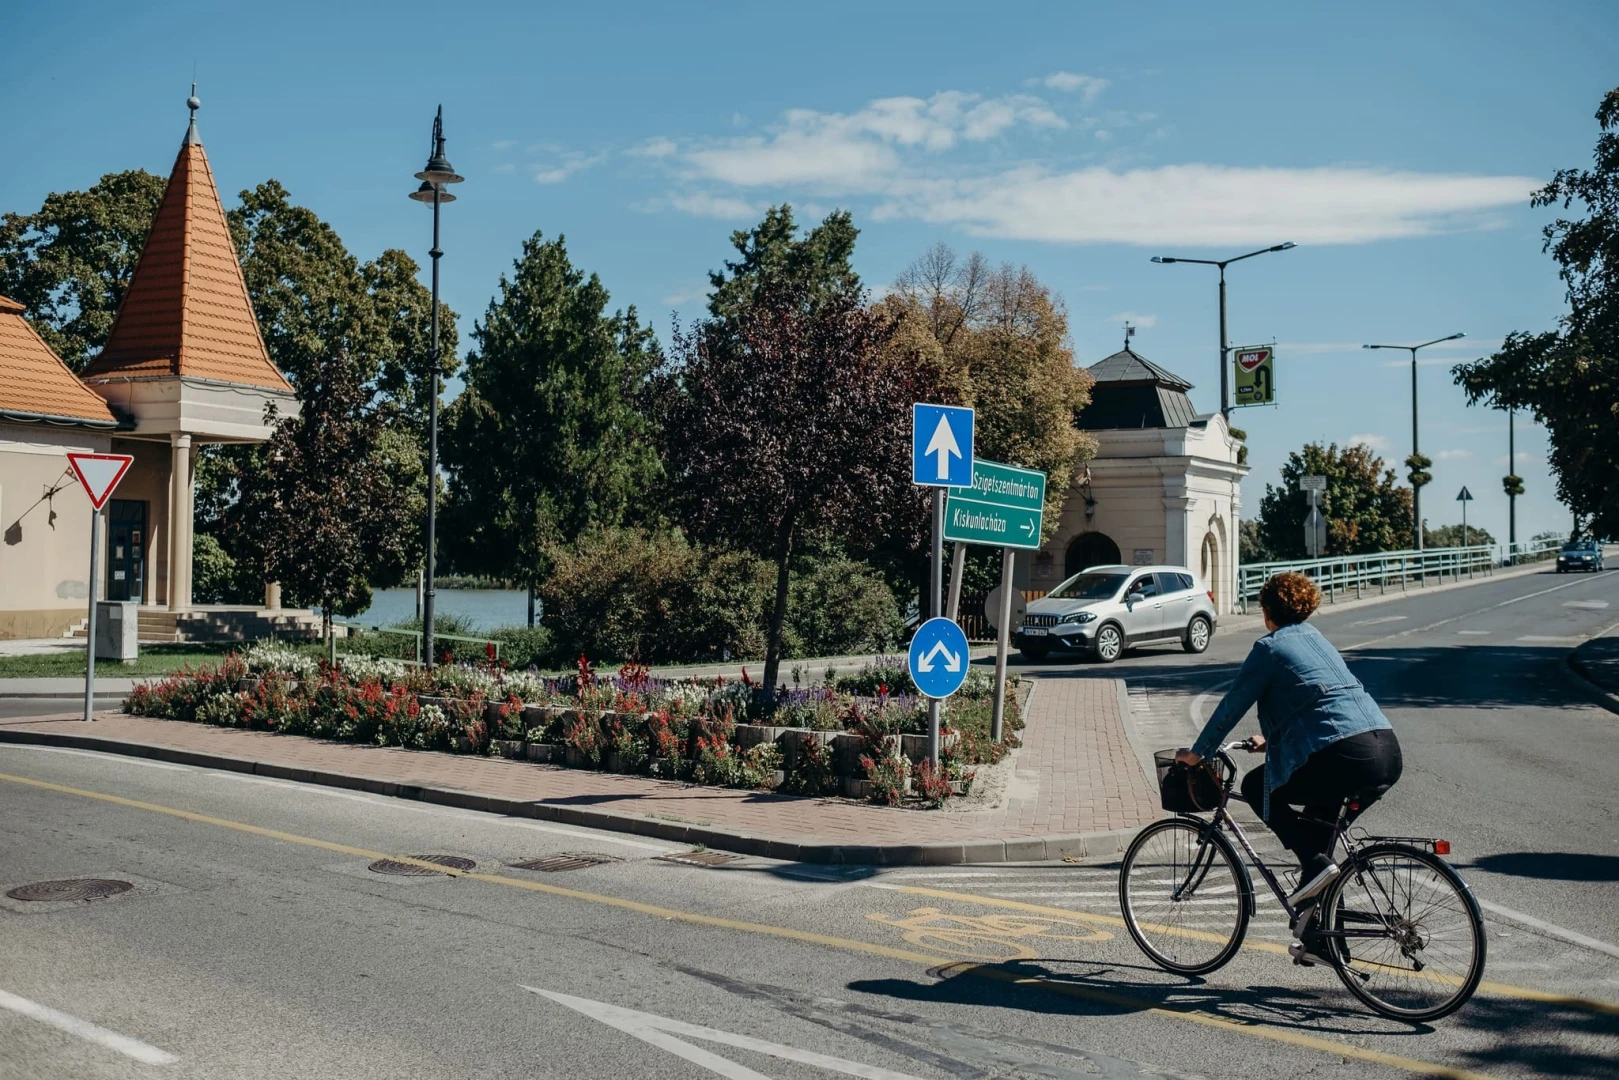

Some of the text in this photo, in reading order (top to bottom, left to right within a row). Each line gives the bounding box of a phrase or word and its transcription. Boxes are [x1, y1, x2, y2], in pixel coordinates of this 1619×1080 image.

[1241, 354, 1258, 363] MOL
[973, 471, 1039, 499] Szigetszentmárton
[953, 508, 1006, 532] Kiskunlacháza
